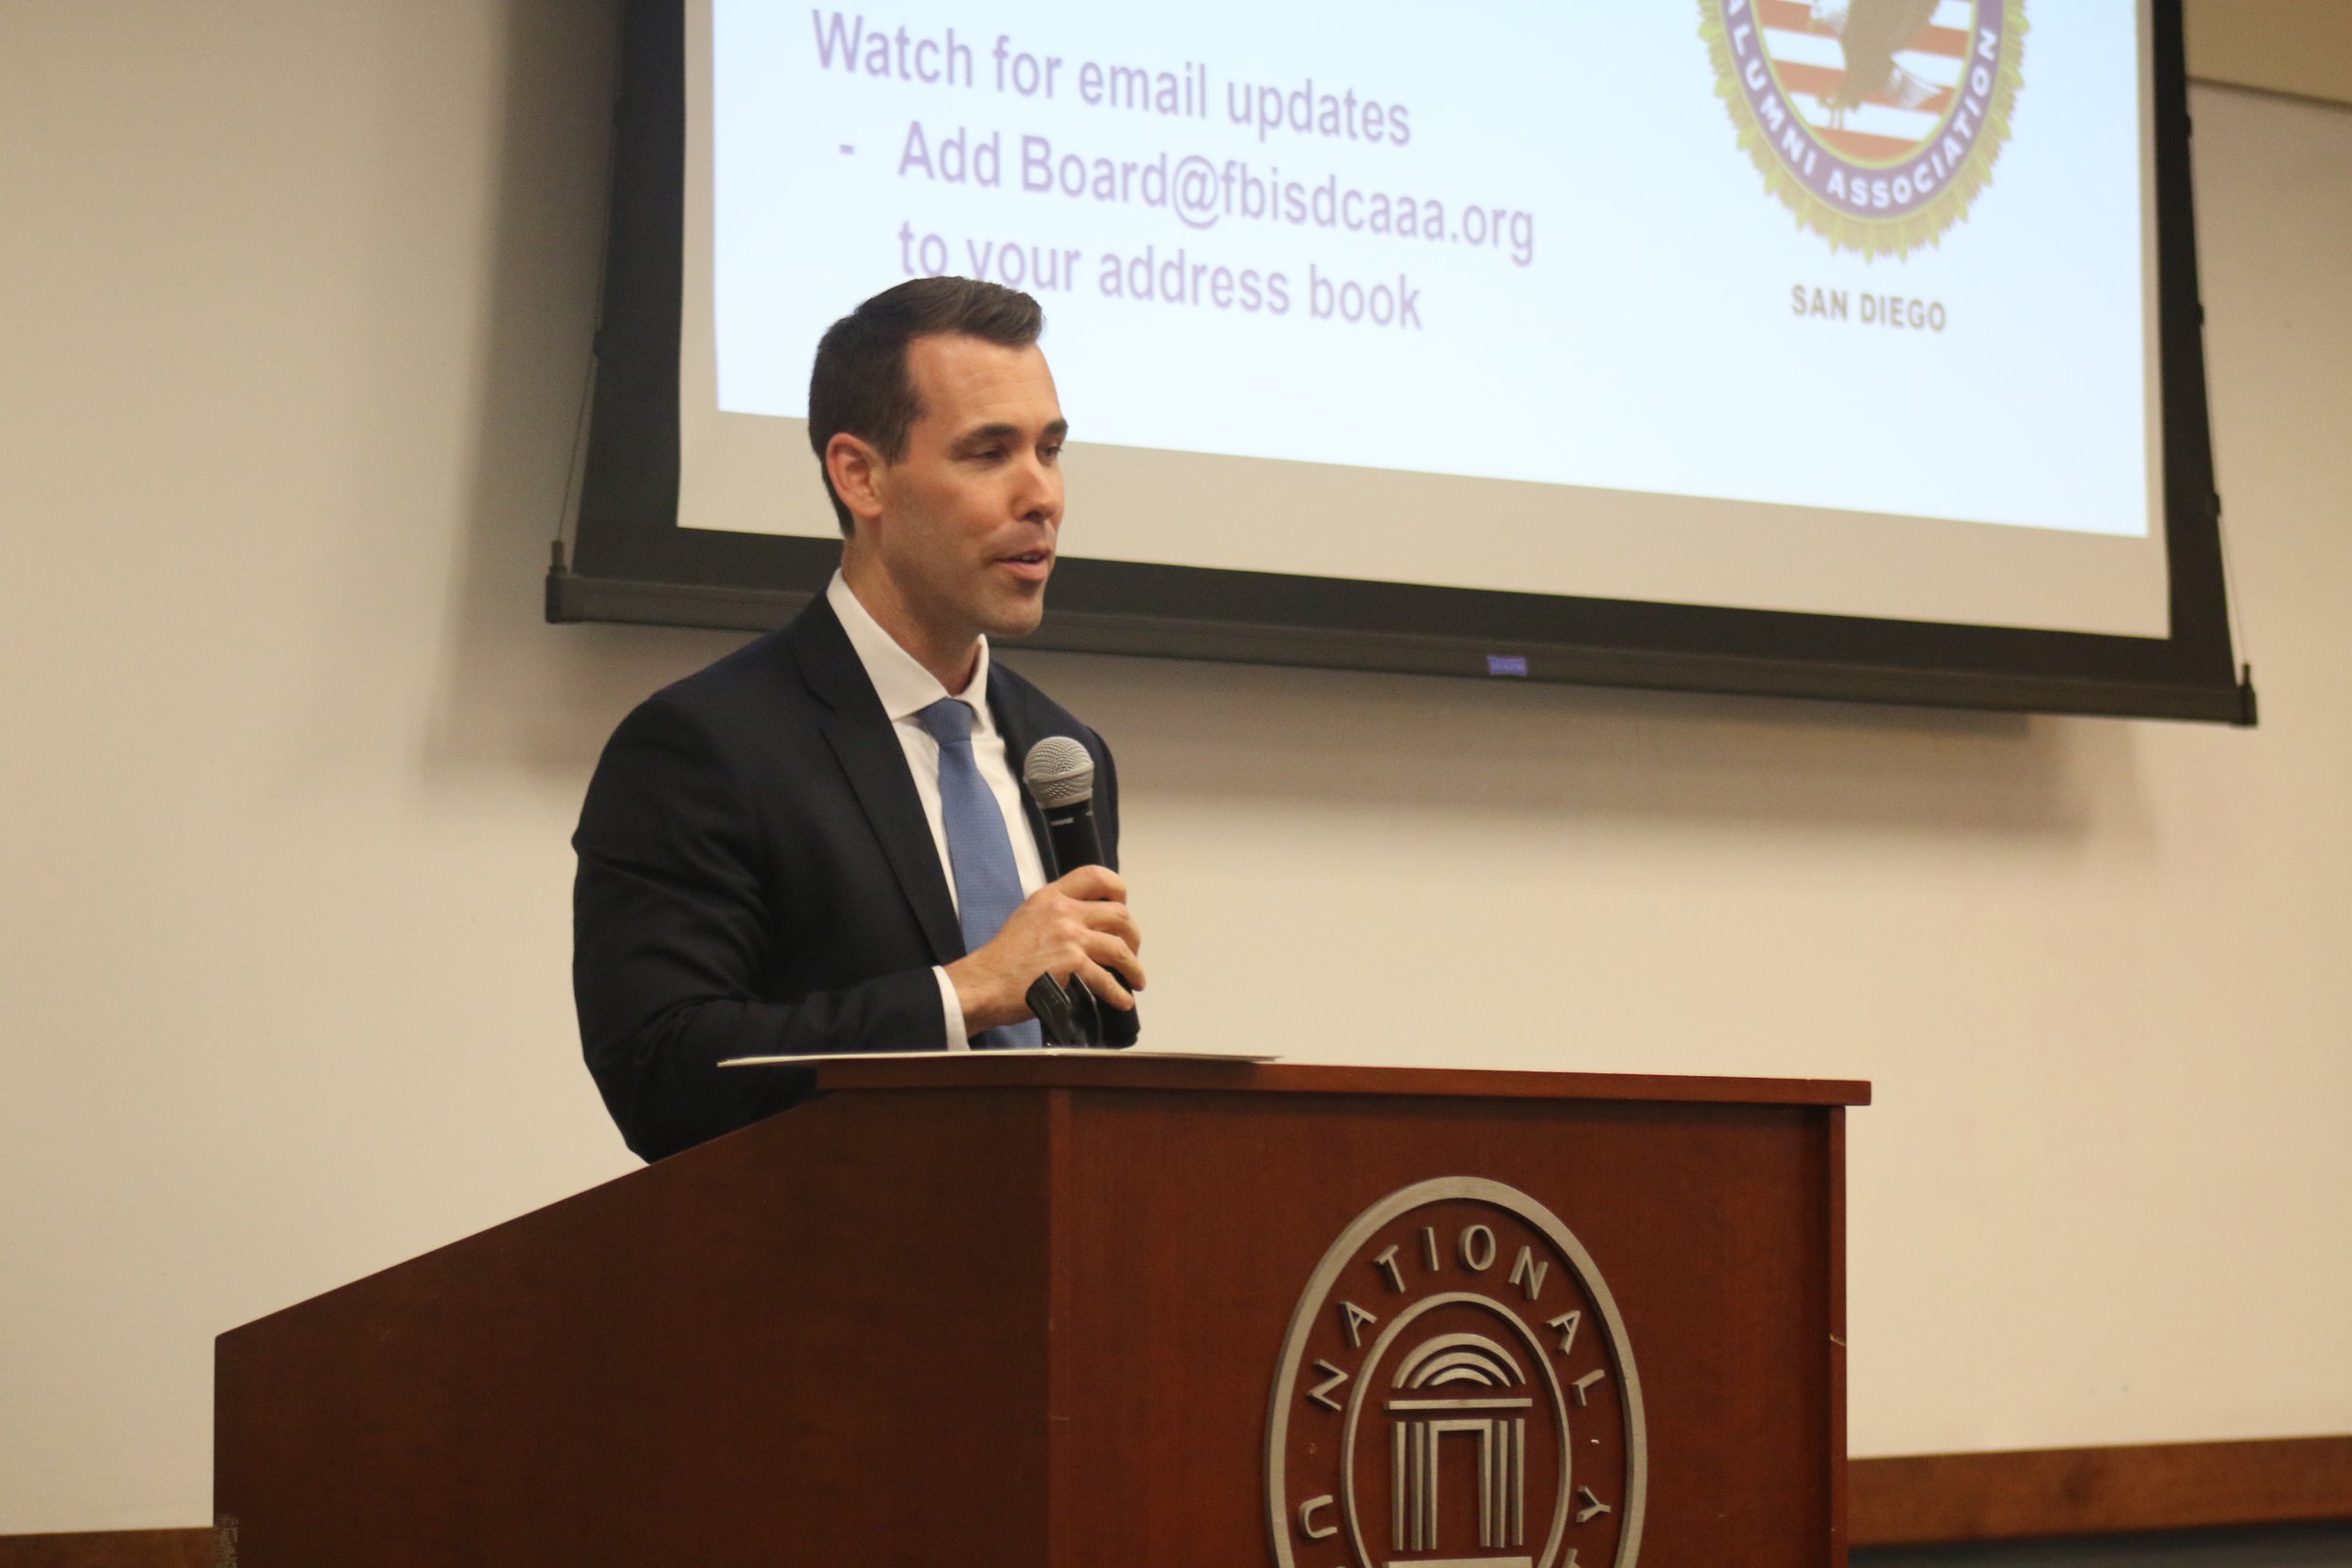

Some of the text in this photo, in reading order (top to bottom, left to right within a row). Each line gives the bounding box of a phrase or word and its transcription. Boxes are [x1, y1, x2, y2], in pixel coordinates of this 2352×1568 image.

[811, 8, 1411, 147] Watch for email updates
[1826, 26, 1998, 209] ASSOCIATION
[898, 120, 1534, 268] Add Board@fbisdcaaa.org
[898, 220, 1422, 330] to your address book
[1791, 284, 1947, 333] SAN DIEGO
[1306, 1224, 1605, 1412] NATIONAL
